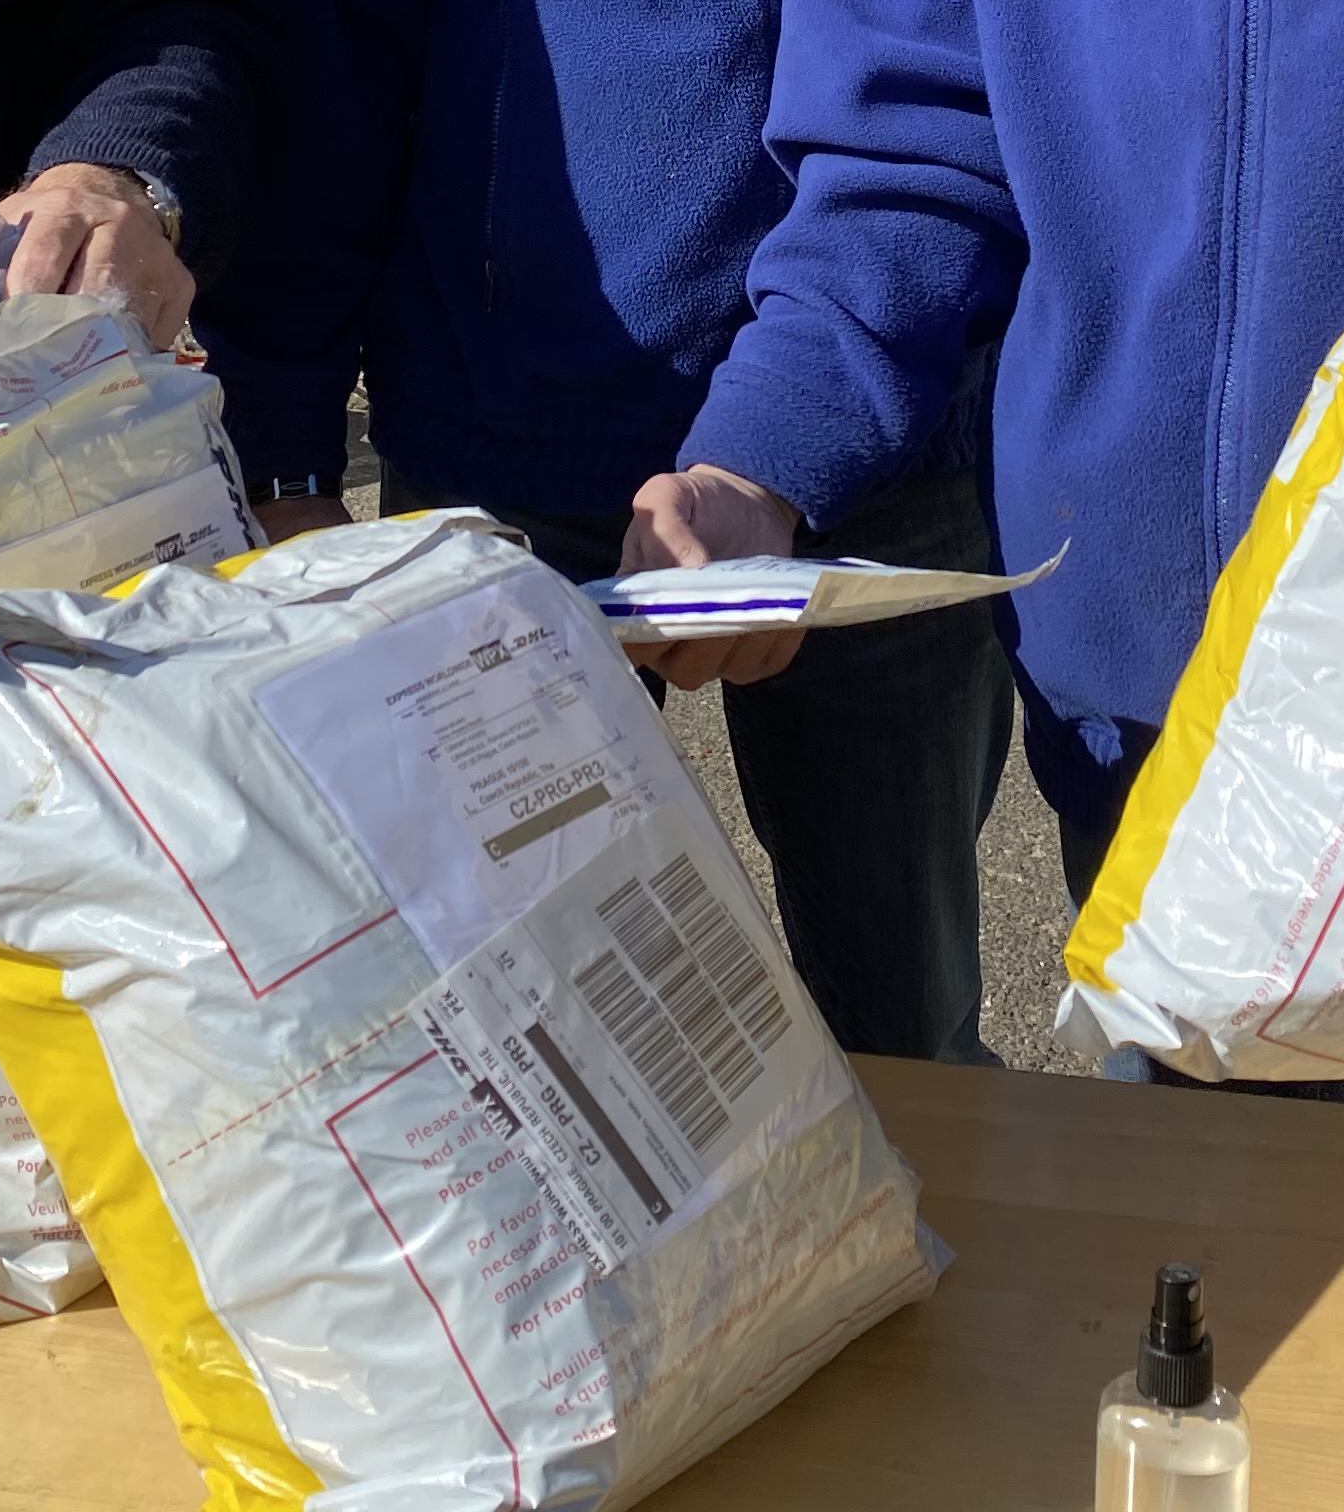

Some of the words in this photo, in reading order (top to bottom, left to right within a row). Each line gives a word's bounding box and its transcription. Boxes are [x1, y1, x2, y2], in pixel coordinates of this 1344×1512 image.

[512, 623, 551, 651] DHL
[468, 768, 507, 793] PRAGUE
[477, 786, 506, 806] Czech
[506, 758, 607, 820] CZ-PRG-PR3
[1275, 892, 1317, 950] weight
[1273, 951, 1288, 965] 3
[440, 987, 466, 1016] PEK
[425, 1019, 471, 1078] DHL
[477, 1045, 499, 1070] THE
[405, 1105, 466, 1148] Please
[537, 1126, 568, 1163] CZECH
[16, 1156, 41, 1175] Por
[417, 1140, 456, 1171] and
[454, 1126, 478, 1148] all
[437, 1170, 486, 1205] Place
[27, 1198, 69, 1217] Veuill
[597, 1211, 616, 1230] 00
[465, 1227, 501, 1257] Por
[498, 1199, 546, 1234] favor
[609, 1227, 630, 1250] 101
[477, 1223, 560, 1280] necesaria
[509, 1311, 544, 1340] Por
[539, 1280, 593, 1319] favor
[536, 1339, 610, 1392] Veuillez
[551, 1396, 575, 1418] et
[573, 1372, 614, 1405] que
